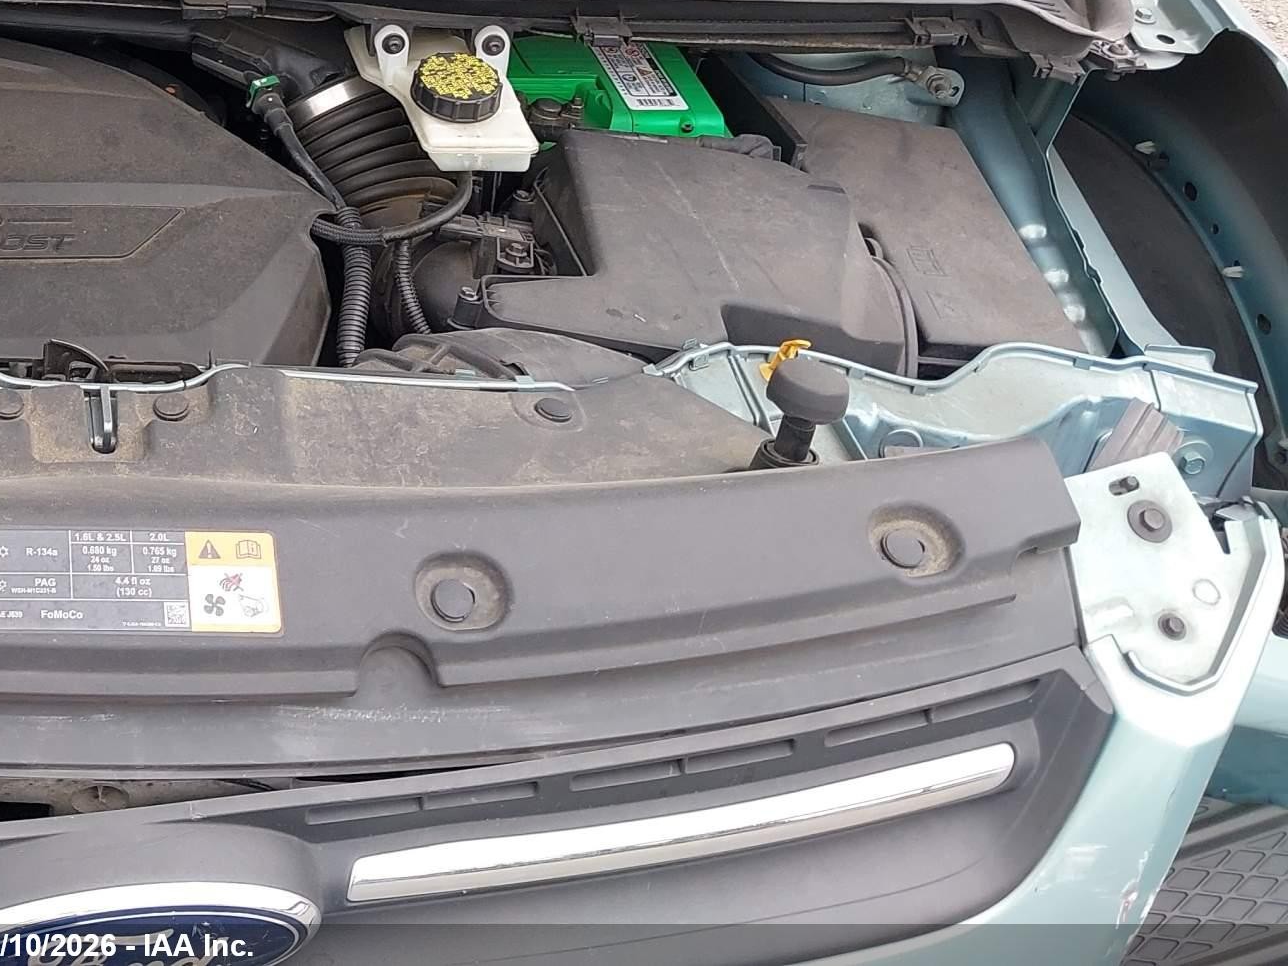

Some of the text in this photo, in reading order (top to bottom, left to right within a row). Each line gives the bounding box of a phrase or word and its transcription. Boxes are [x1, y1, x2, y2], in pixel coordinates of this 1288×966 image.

[106, 533, 127, 542] 2.5L
[149, 533, 169, 542] 2.0L
[26, 547, 58, 557] R-134a
[106, 546, 117, 557] kg
[166, 547, 177, 558] kg
[34, 577, 57, 587] PAG
[115, 576, 130, 585] 4.4
[139, 578, 151, 586] oz
[116, 587, 152, 598] (130 cc)
[41, 610, 84, 620] FoMoCo
